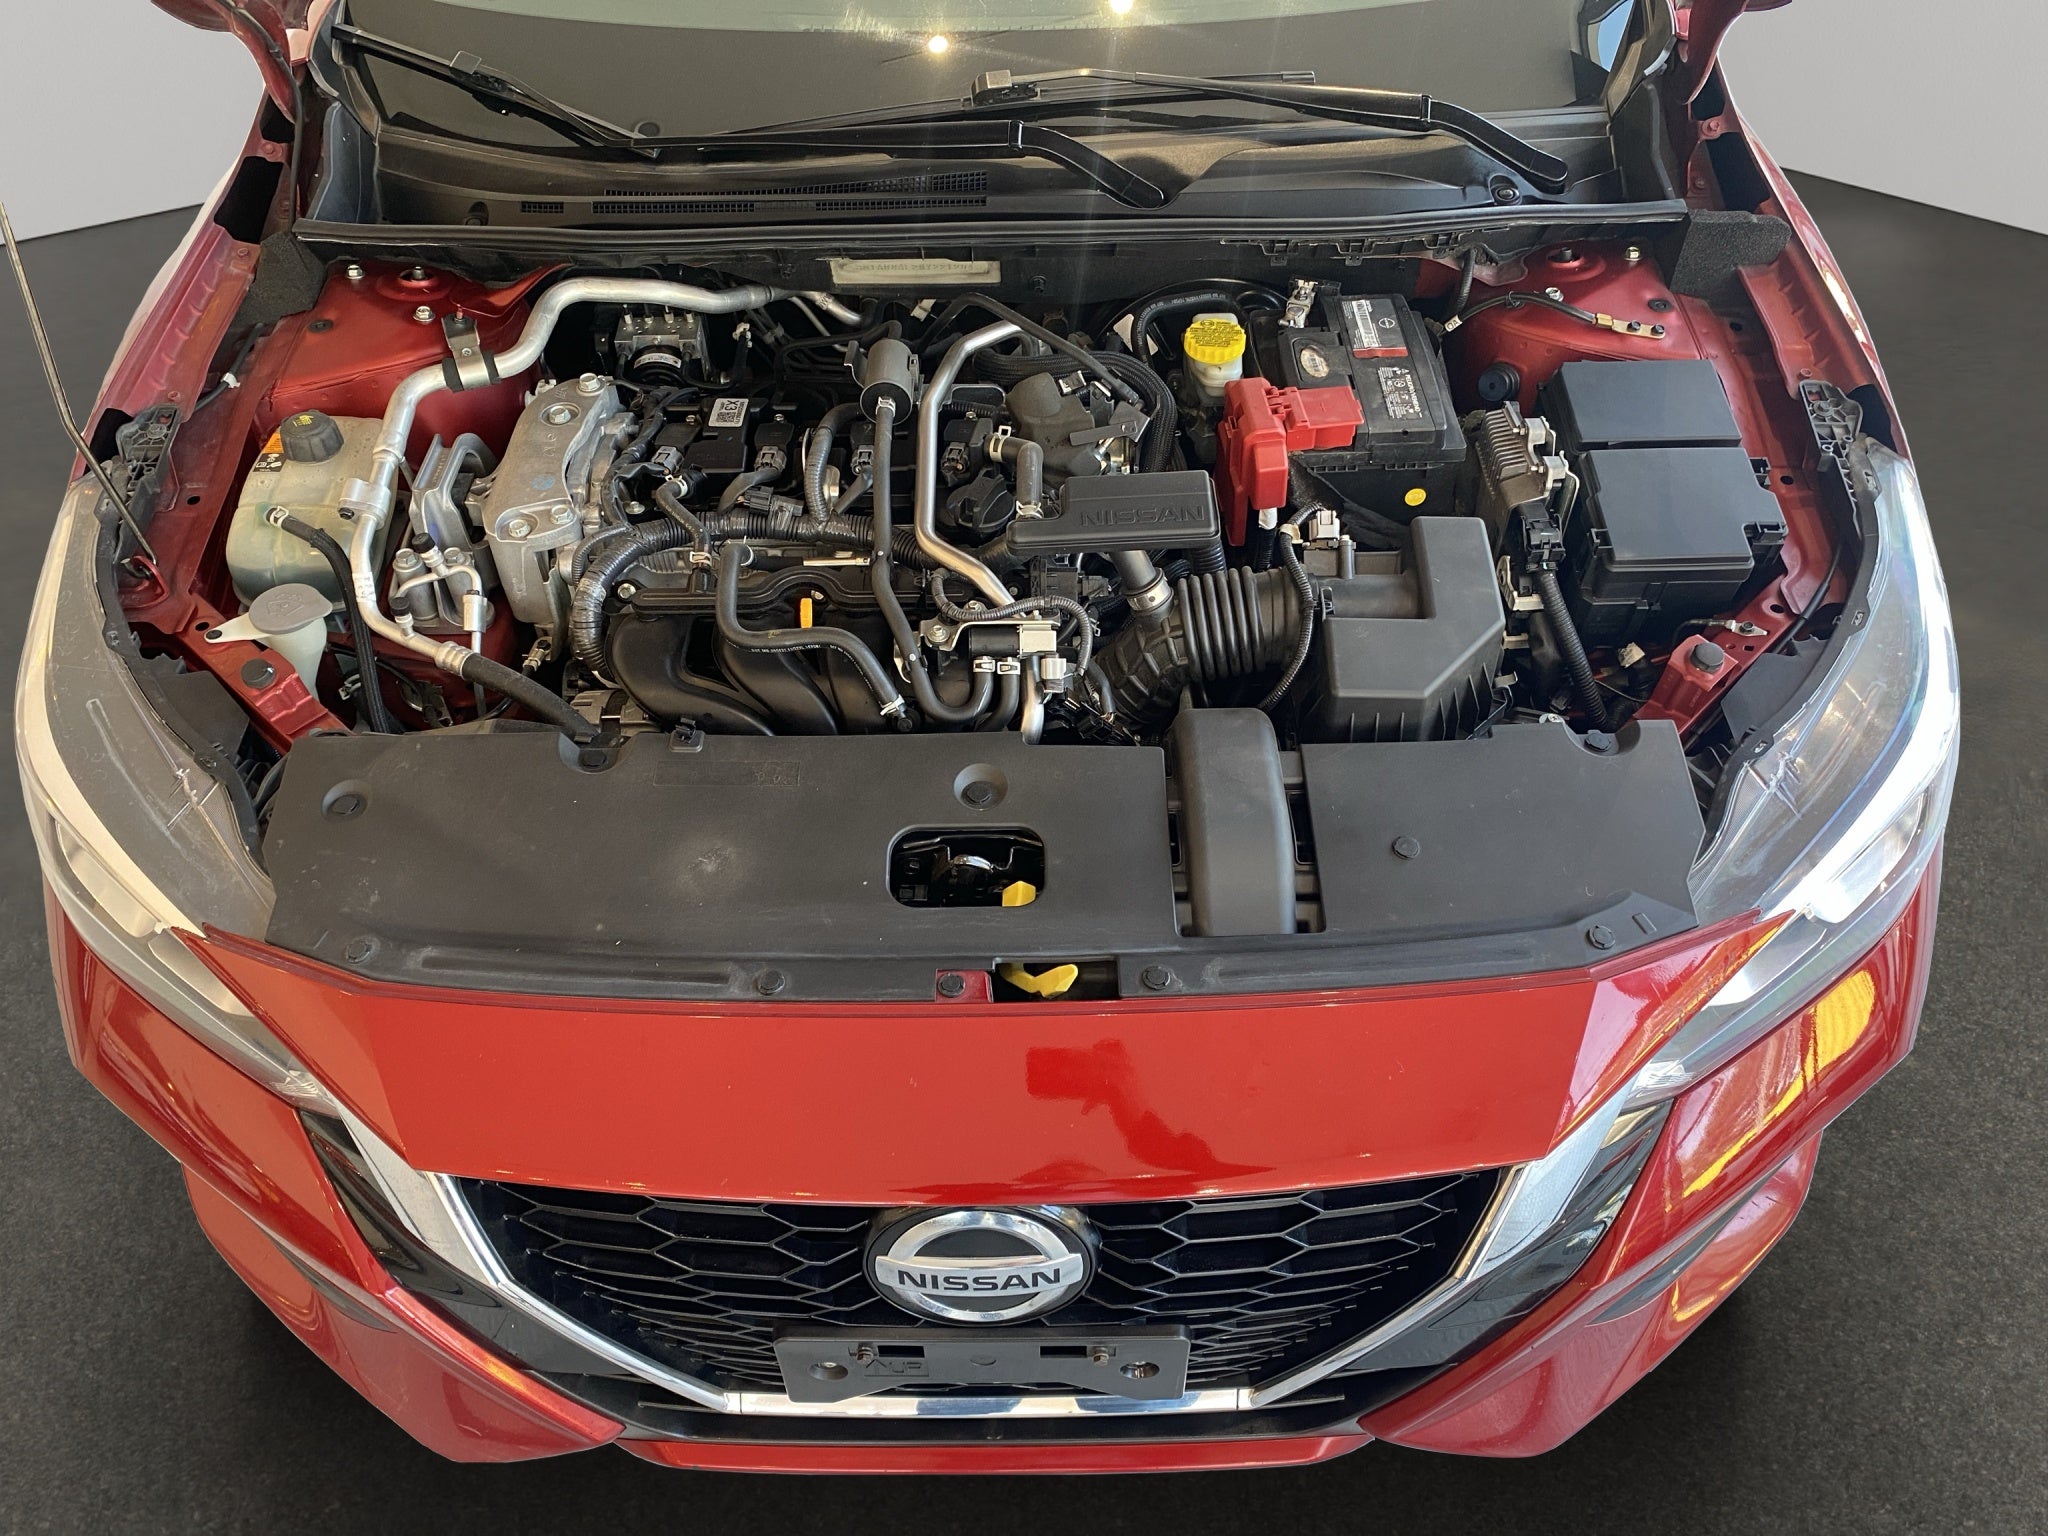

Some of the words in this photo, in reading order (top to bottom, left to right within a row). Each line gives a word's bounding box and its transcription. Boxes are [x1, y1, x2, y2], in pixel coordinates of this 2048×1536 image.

[725, 400, 739, 411] X3
[1082, 505, 1205, 526] NISSAN
[897, 1268, 1060, 1291] NISSAN
[889, 1361, 921, 1374] UP
